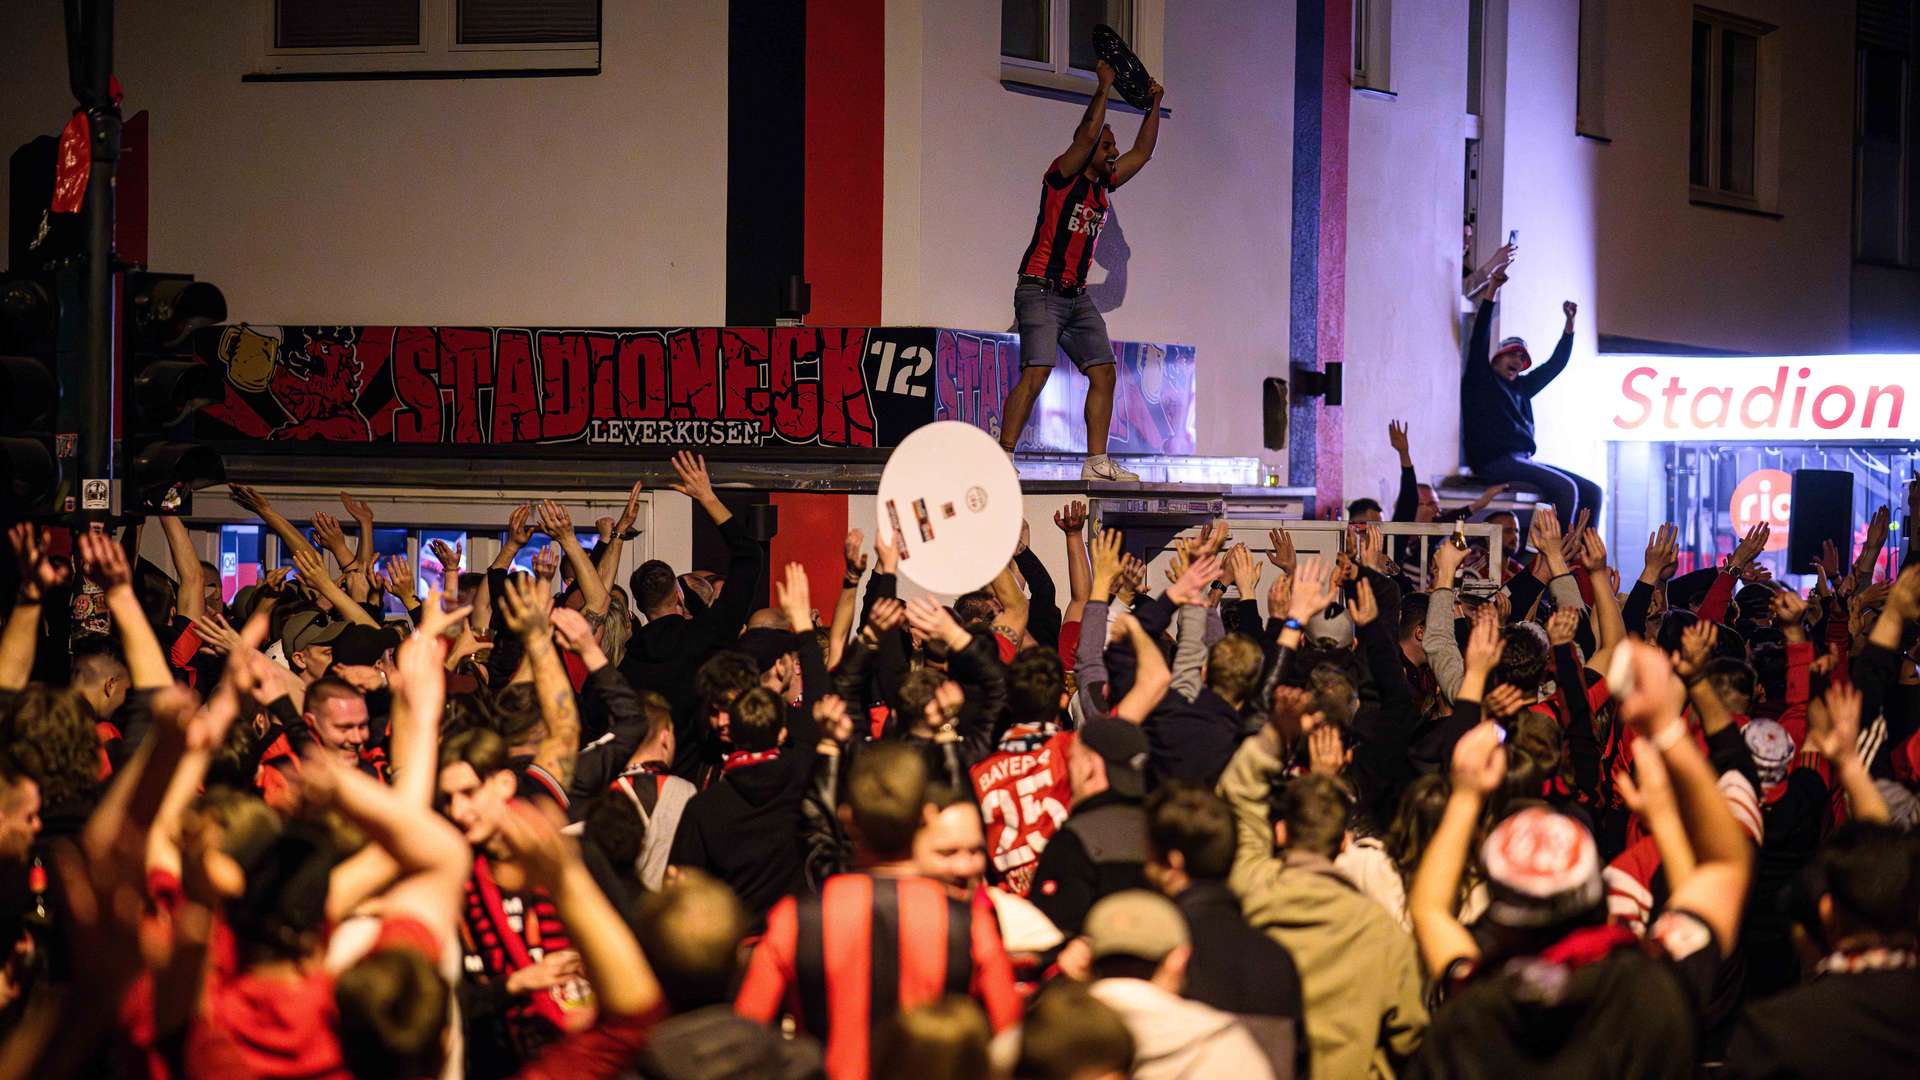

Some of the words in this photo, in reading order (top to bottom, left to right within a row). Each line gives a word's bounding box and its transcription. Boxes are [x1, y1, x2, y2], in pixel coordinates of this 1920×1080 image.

[870, 341, 933, 398] 12
[1613, 366, 1905, 430] Stadion
[591, 420, 761, 446] LEVERKUSEN
[981, 769, 1069, 872] 25
